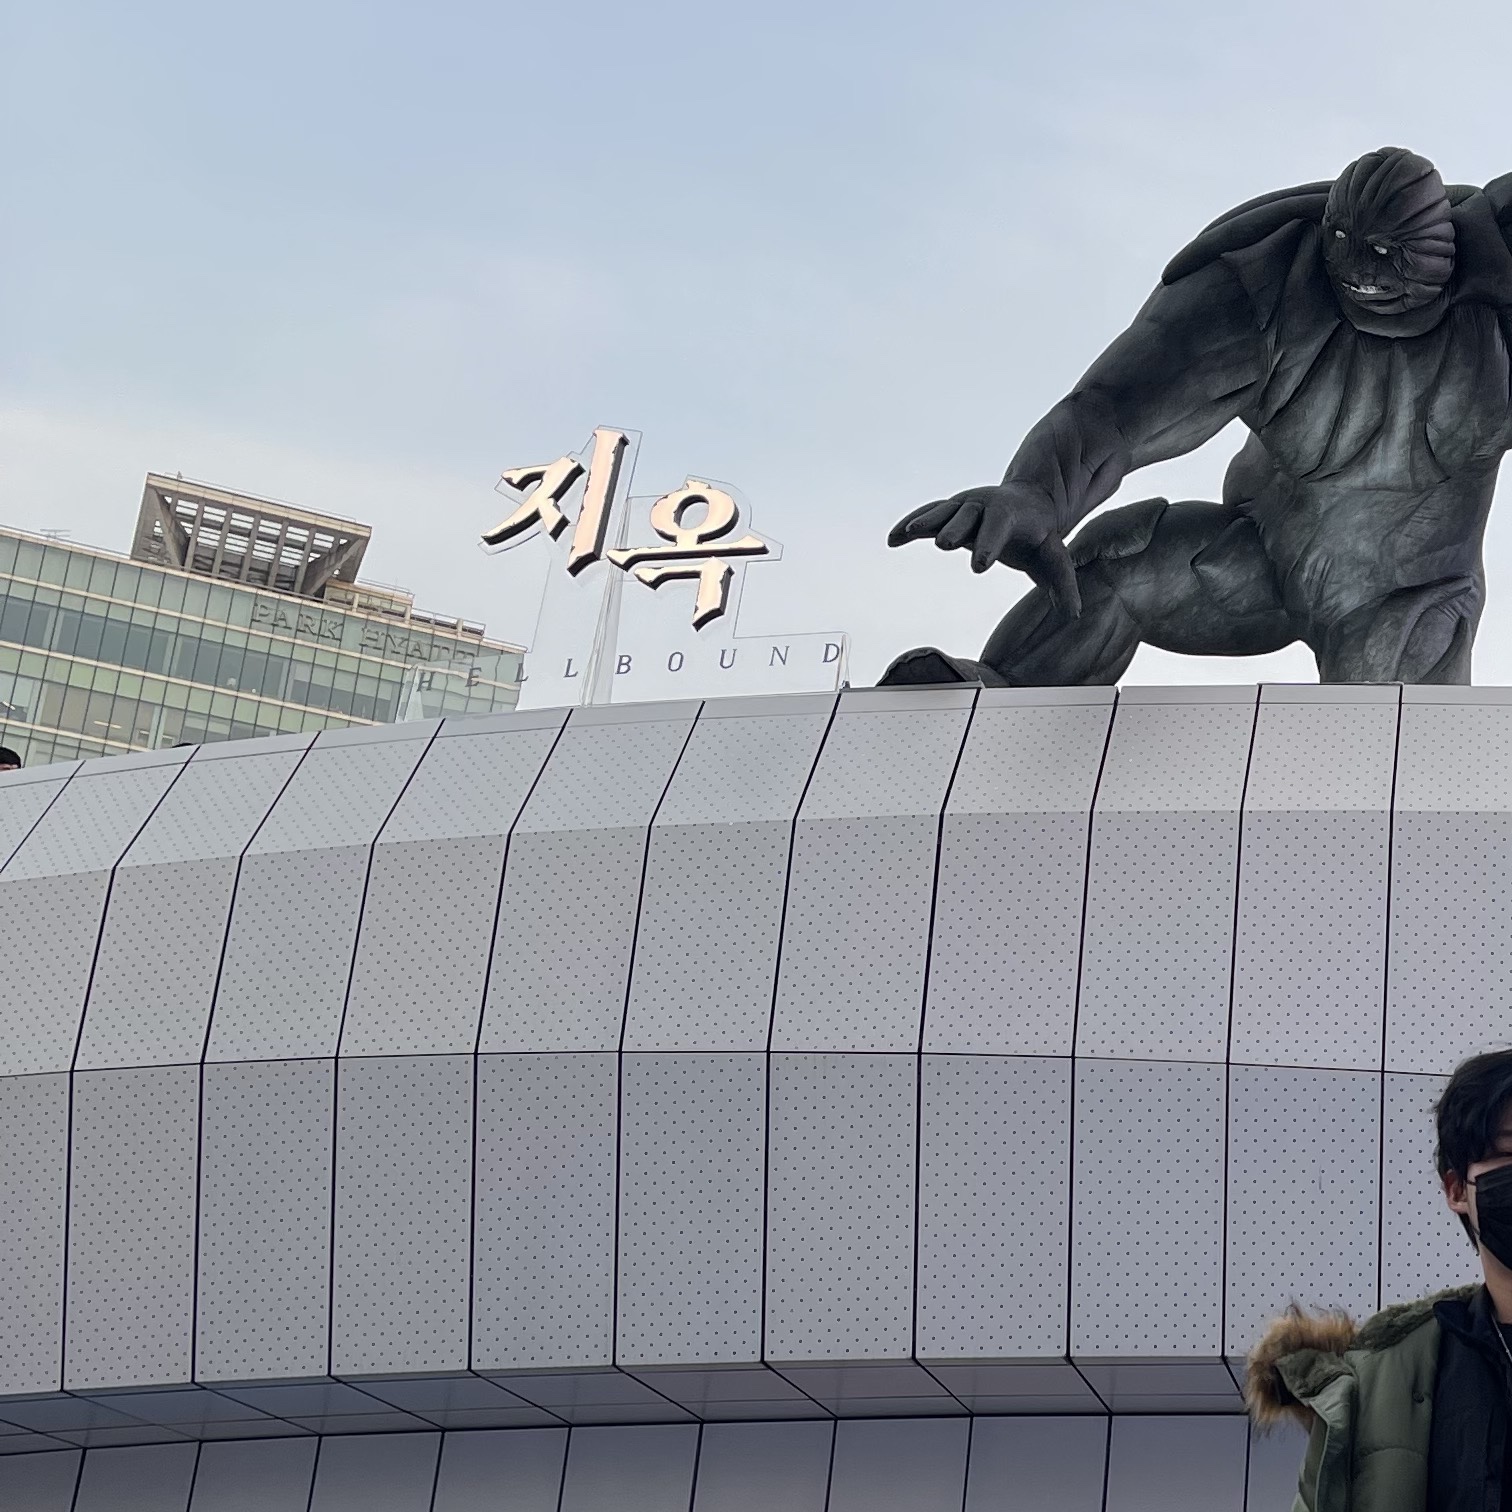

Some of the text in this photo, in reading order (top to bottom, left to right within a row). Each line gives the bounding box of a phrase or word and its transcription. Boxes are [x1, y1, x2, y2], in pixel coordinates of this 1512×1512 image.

[481, 428, 770, 633] 지옥
[251, 602, 345, 642] PARK
[416, 642, 842, 693] HELLBOUND
